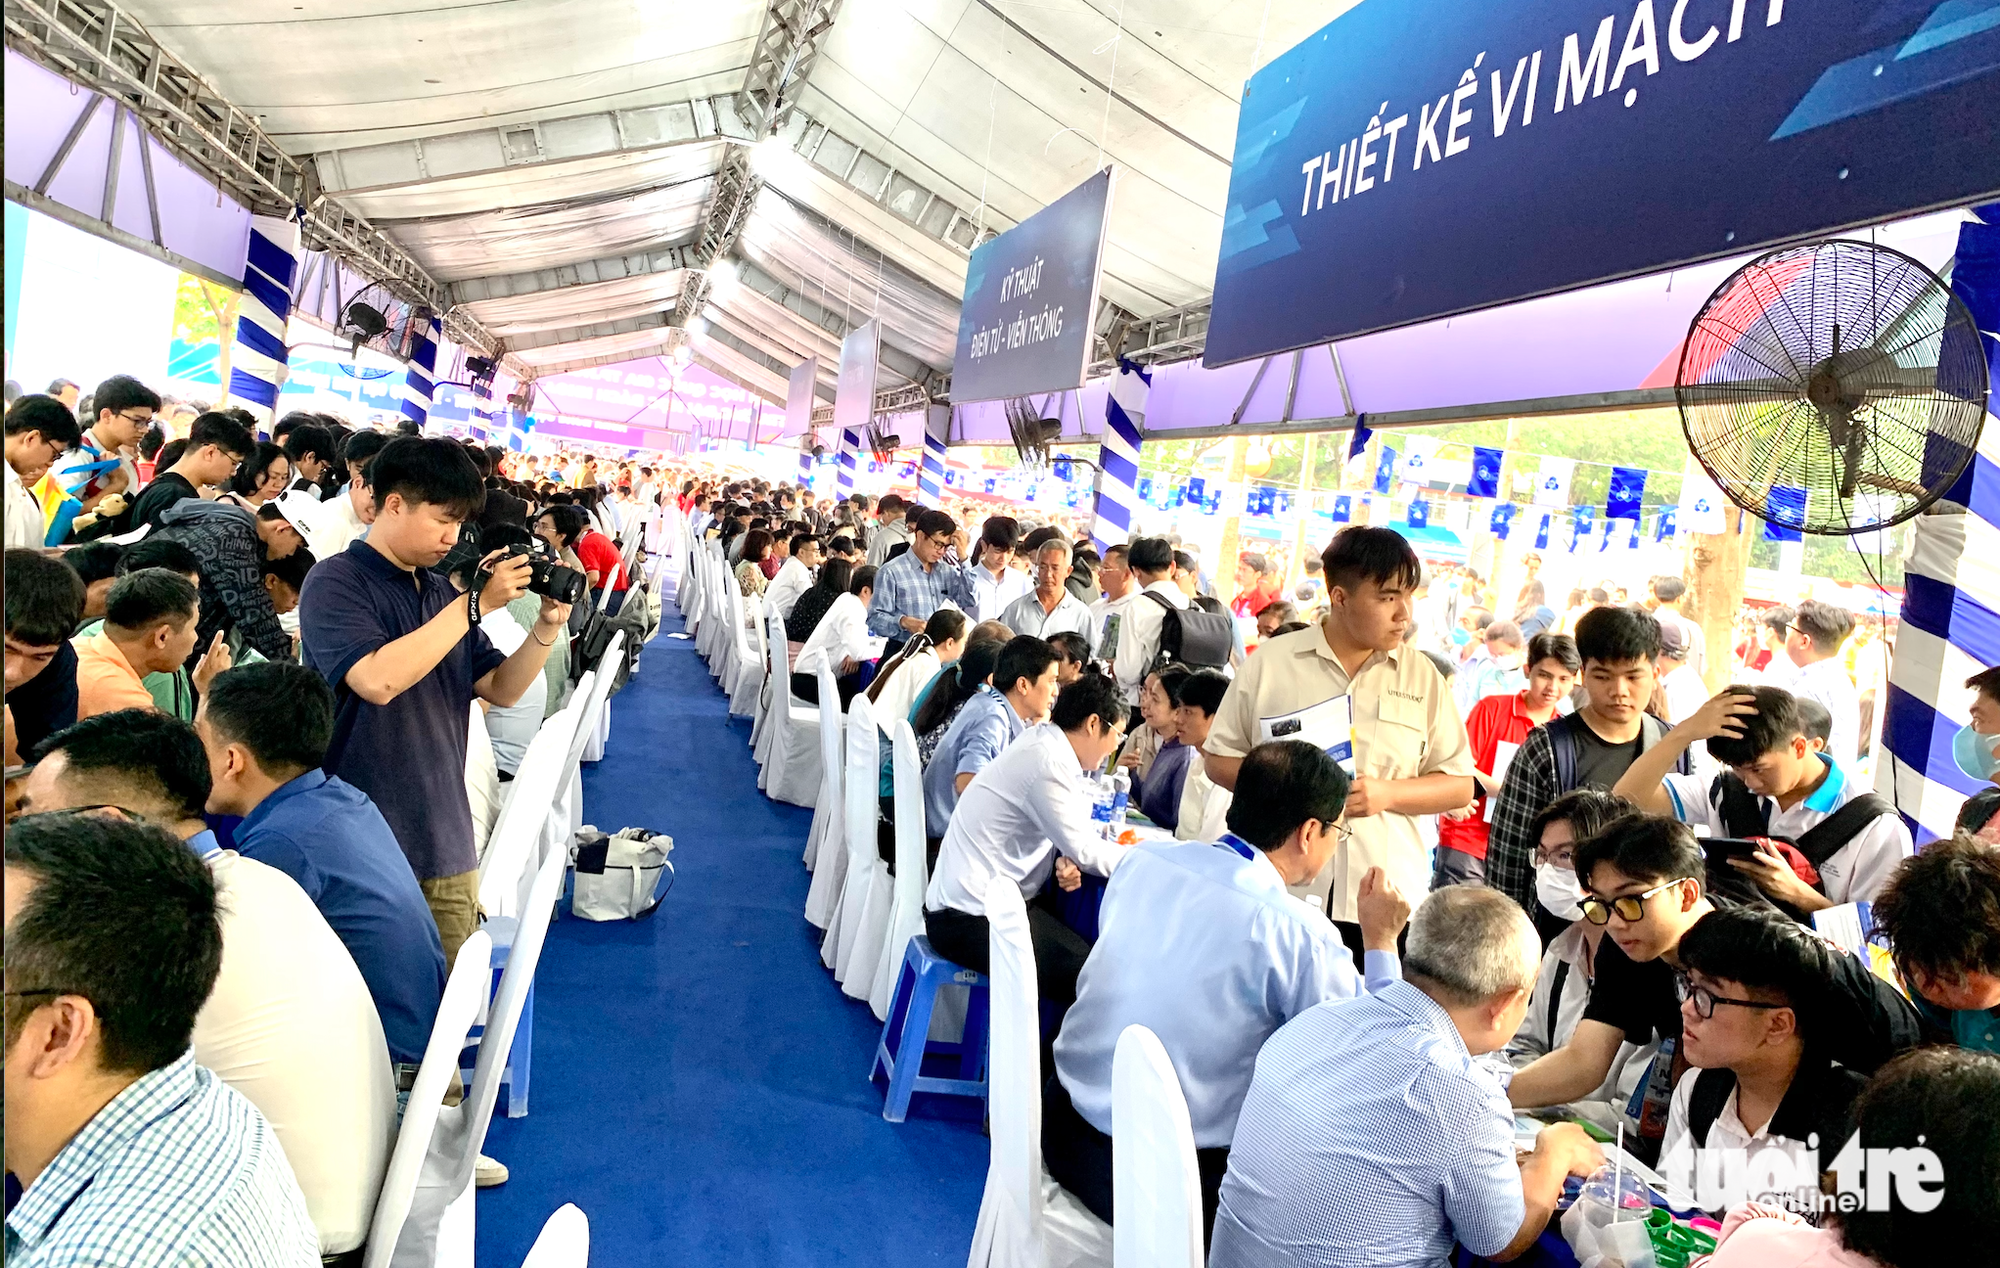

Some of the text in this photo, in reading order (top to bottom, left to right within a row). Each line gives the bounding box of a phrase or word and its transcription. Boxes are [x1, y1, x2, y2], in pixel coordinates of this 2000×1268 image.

[1301, 100, 1409, 217] THIẾT
[1412, 51, 1487, 171] KẾ
[1490, 49, 1543, 138] VI
[1013, 254, 1044, 300] THUẬT
[970, 325, 991, 364] ĐIỆN
[1006, 309, 1029, 351] VIỄN
[1027, 303, 1064, 346] THÔNG
